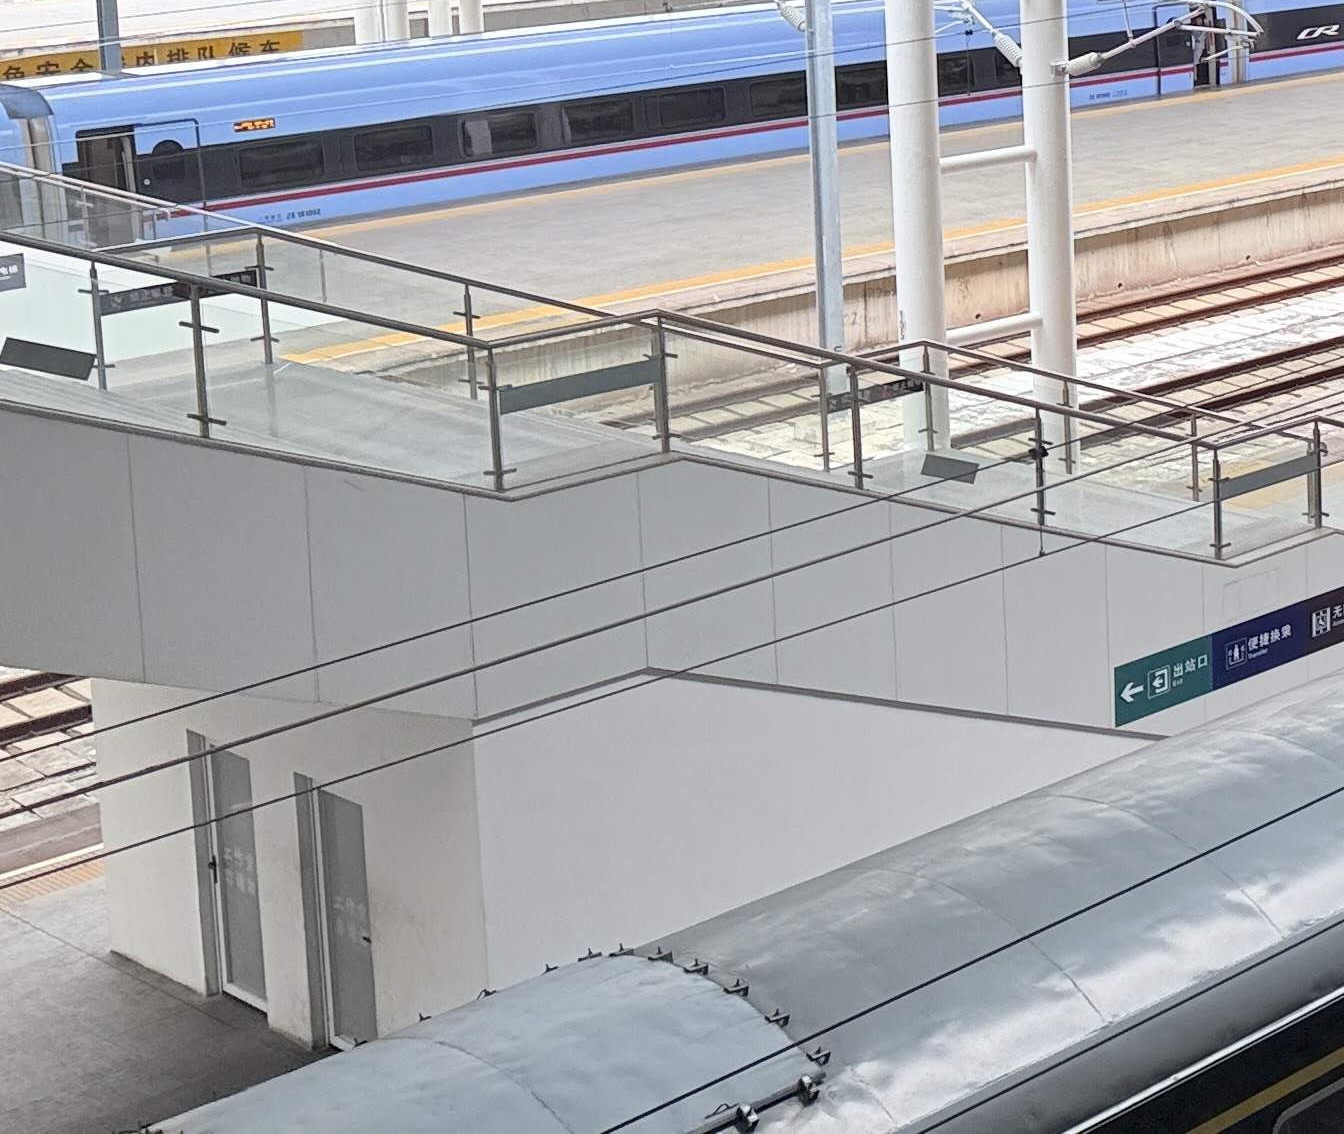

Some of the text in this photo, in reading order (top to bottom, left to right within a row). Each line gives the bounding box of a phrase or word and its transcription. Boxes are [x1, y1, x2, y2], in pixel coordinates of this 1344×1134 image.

[1297, 24, 1340, 40] CR
[2, 39, 280, 78] 色安全内排队候车
[1247, 623, 1292, 651] 便捷换乘
[1173, 654, 1208, 678] 出站口
